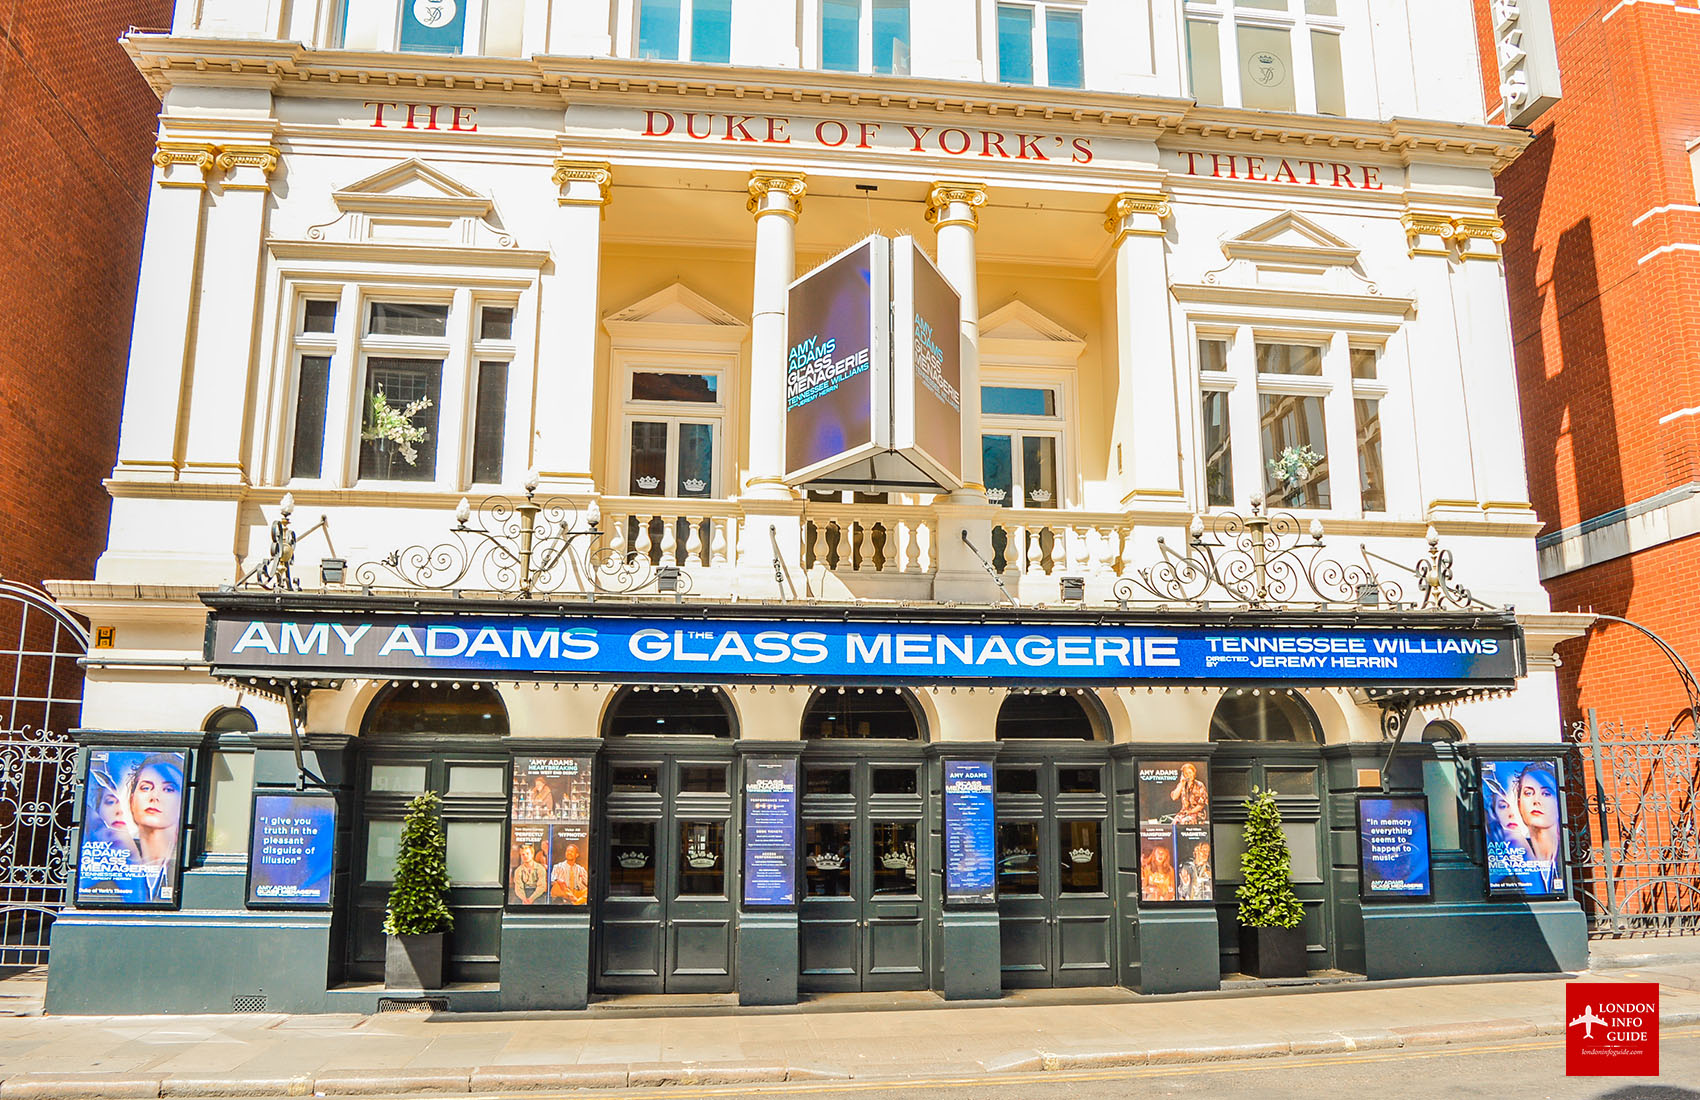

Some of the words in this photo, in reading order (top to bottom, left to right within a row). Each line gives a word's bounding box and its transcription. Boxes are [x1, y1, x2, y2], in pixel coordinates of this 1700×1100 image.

[363, 102, 478, 132] THE
[641, 110, 791, 143] DUKE
[814, 120, 882, 149] OF
[904, 125, 1094, 164] YORK'S
[1177, 151, 1384, 190] THEATRE
[915, 313, 933, 338] AMY
[788, 335, 817, 361] AMY
[915, 325, 943, 363] ADAMS
[788, 338, 836, 373] ADAMS
[914, 338, 942, 374] GLASS
[788, 354, 832, 386] GLASS
[788, 348, 869, 398] MENAGERIE
[914, 350, 960, 405] MENAGERIE
[788, 381, 830, 405] TENNESSEE
[830, 362, 869, 385] WILLIAMS
[231, 621, 372, 655] AMY
[378, 624, 600, 660] ADAMS
[687, 631, 714, 640] THE
[1205, 636, 1367, 654] TENNESSEE
[1373, 638, 1498, 655] WILLIAMS
[628, 629, 828, 664] GLASS
[846, 632, 1181, 667] MENAGERIE
[1250, 656, 1328, 668] JEREMY
[1331, 656, 1397, 668] HERRIN
[263, 827, 288, 835] truth
[290, 827, 299, 835] in
[302, 827, 318, 835] the
[271, 817, 292, 826] give
[294, 818, 311, 826] you
[82, 841, 113, 849] AMY
[262, 846, 302, 855] disguise
[305, 846, 316, 855] of
[263, 837, 304, 845] pleasant
[1372, 846, 1400, 854] happen
[81, 856, 127, 865] GLASS
[82, 849, 130, 857] ADAMS
[262, 856, 302, 864] illusion"
[1488, 860, 1551, 868] MENAGERIE
[80, 864, 160, 872] MENAGERIE
